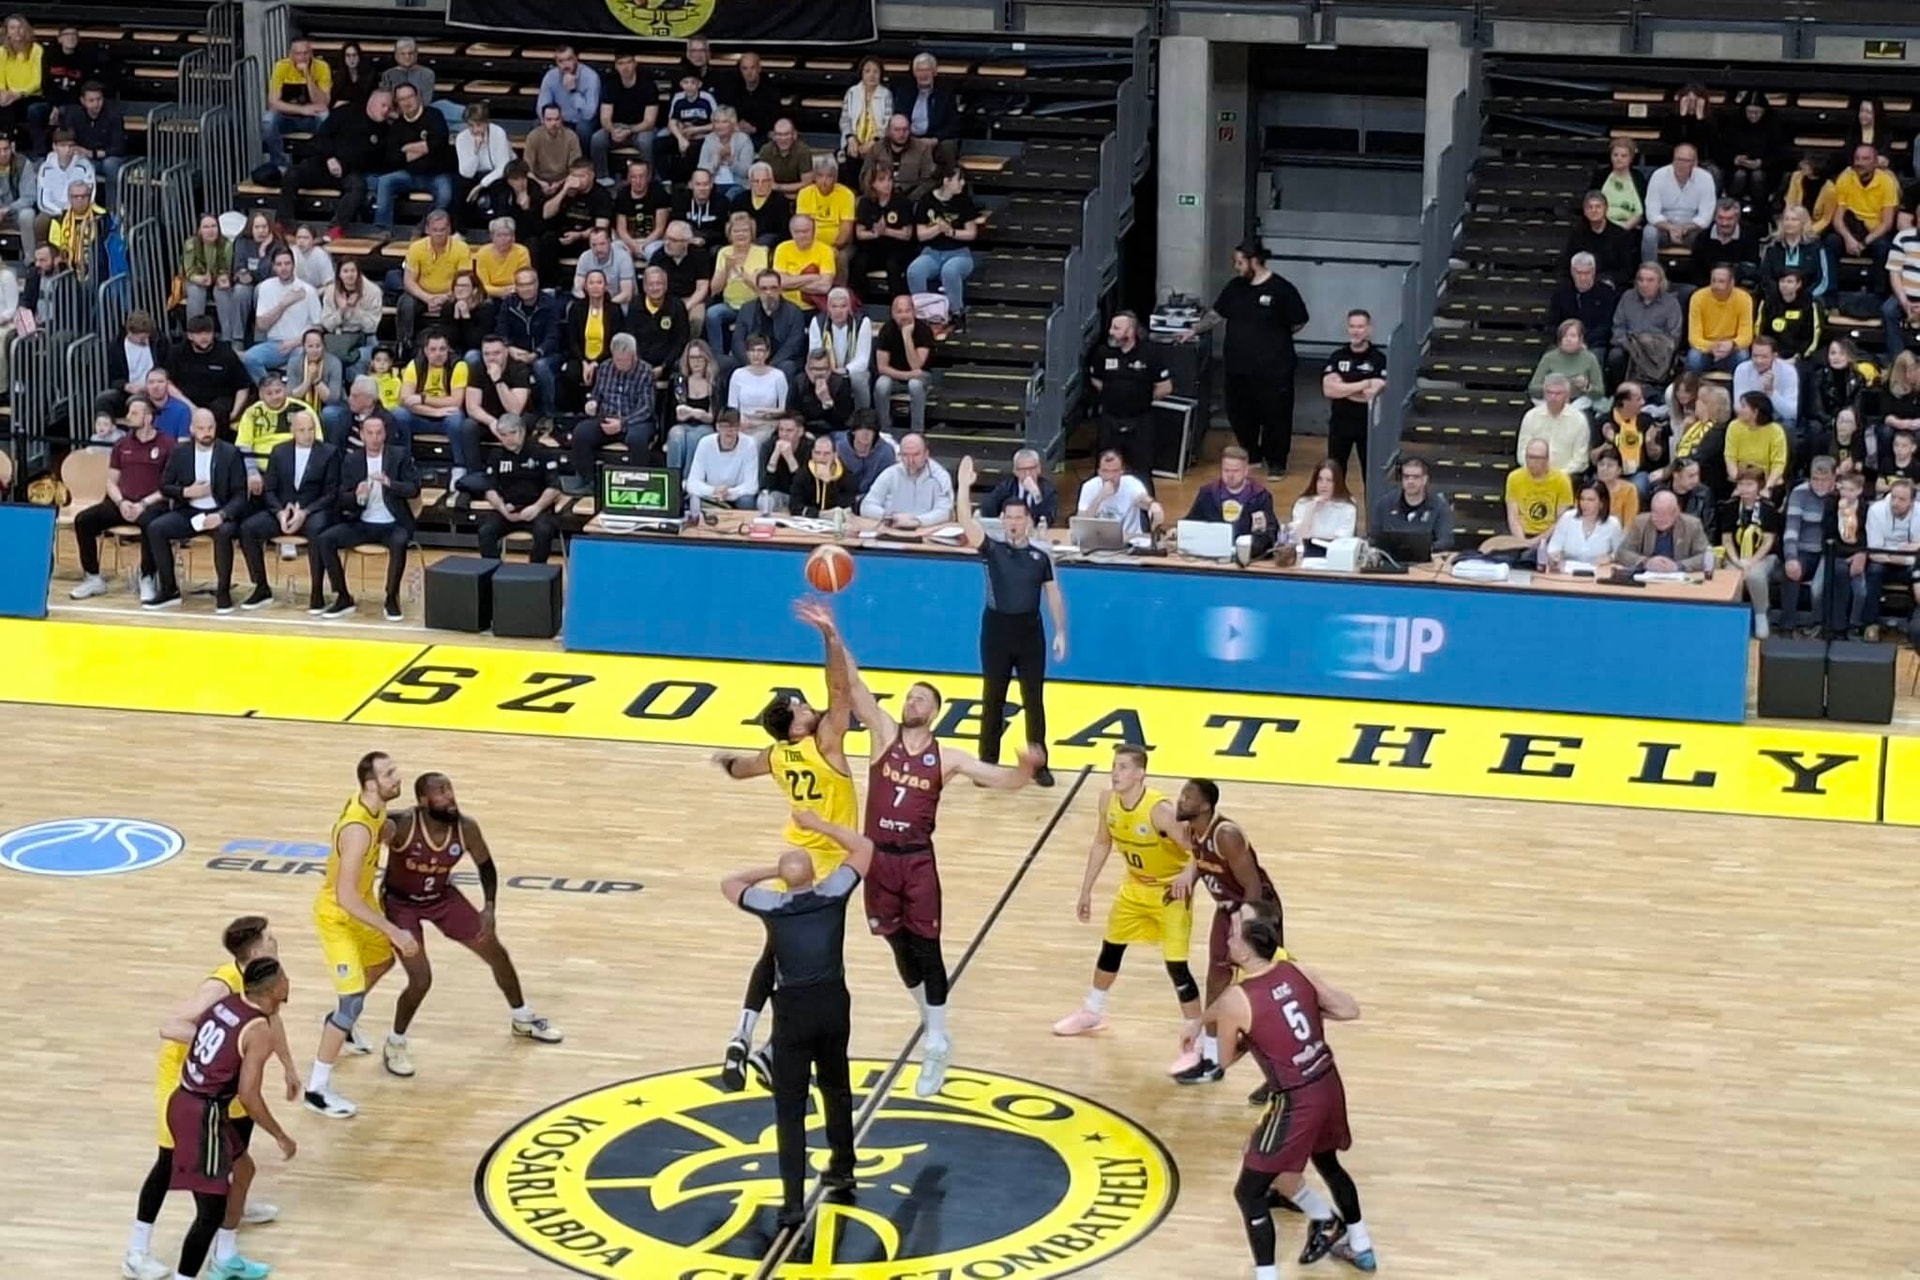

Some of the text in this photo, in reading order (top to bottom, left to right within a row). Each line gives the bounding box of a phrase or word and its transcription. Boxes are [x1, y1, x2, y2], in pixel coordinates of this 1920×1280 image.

[611, 491, 661, 505] VAR
[785, 770, 822, 801] 22
[892, 786, 906, 807] 7
[220, 838, 330, 859] FIB
[205, 856, 645, 895] EURE CUP
[424, 877, 436, 891] 2
[1282, 1000, 1310, 1040] 5
[193, 1019, 226, 1065] 99
[506, 1114, 635, 1268] KOSÁRLABDA
[889, 1156, 1148, 1280] OMBATHELY
